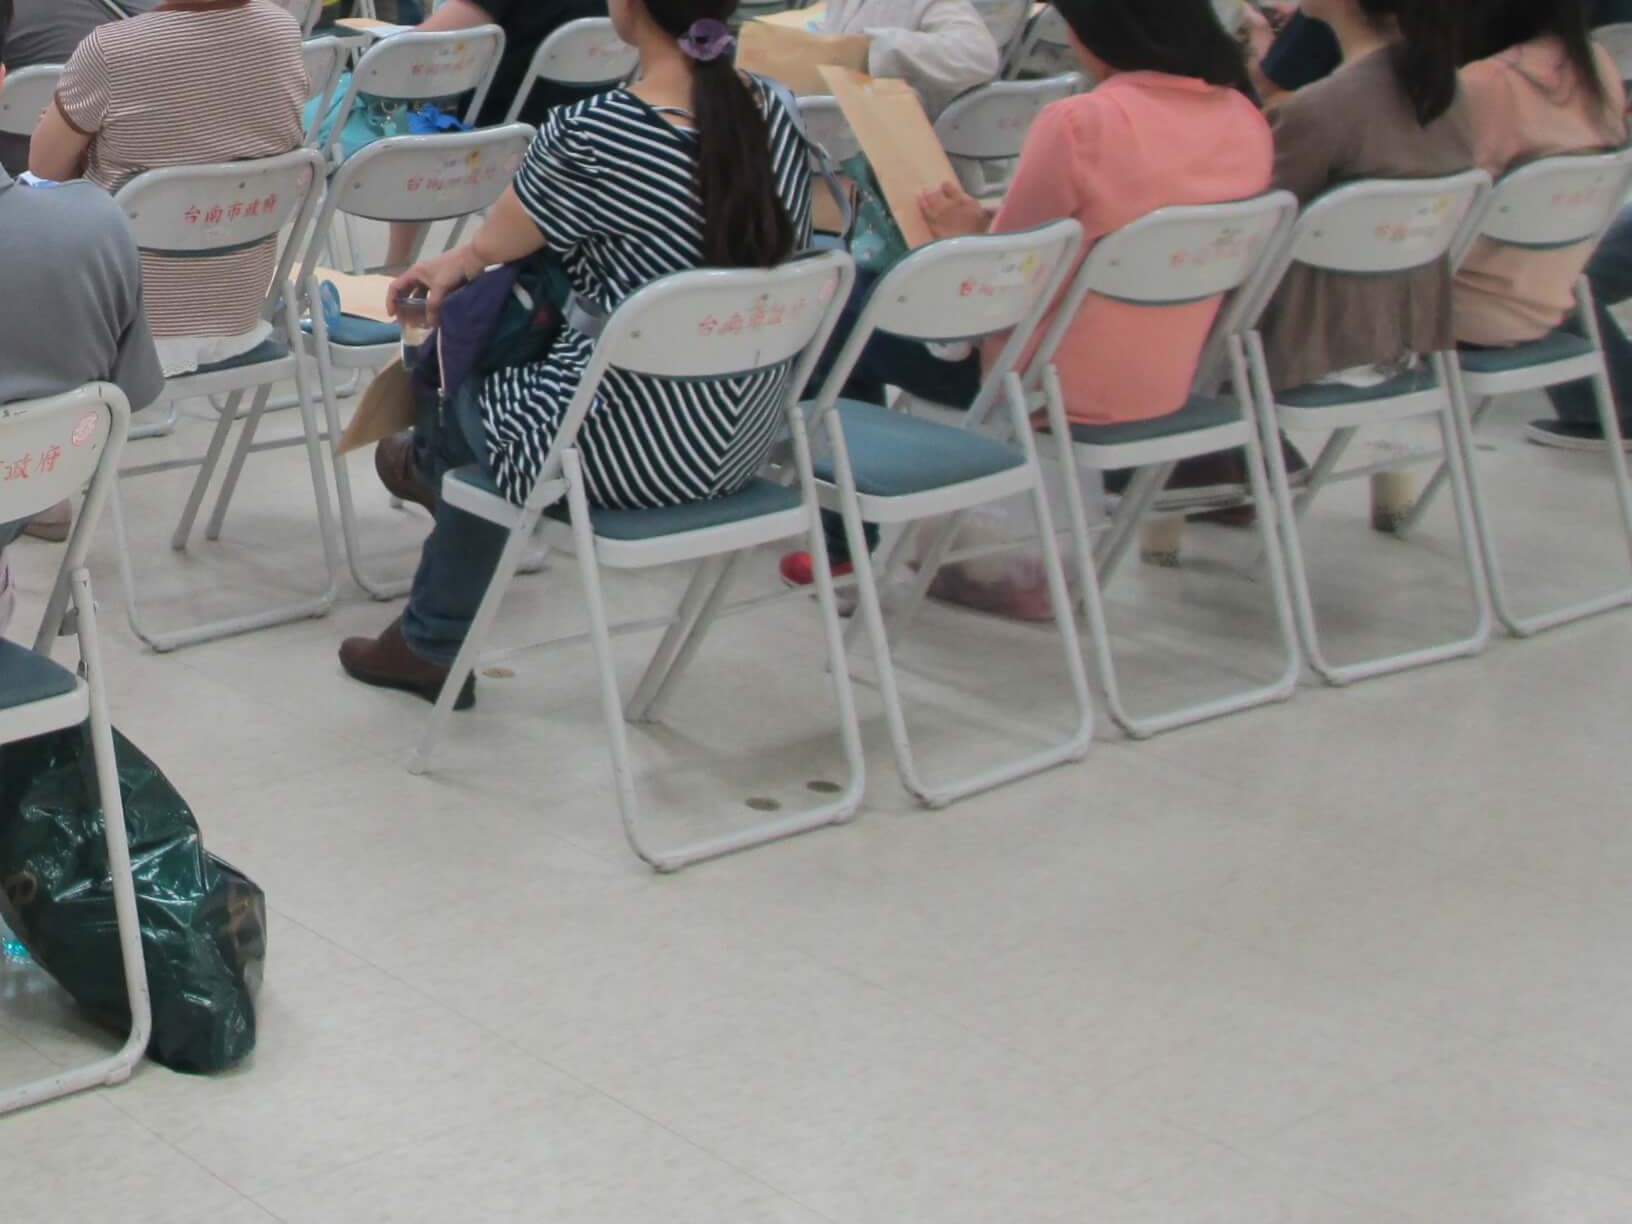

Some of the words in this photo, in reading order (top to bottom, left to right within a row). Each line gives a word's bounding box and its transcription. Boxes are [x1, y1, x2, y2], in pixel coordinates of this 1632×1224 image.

[184, 192, 279, 223] 台南市政府
